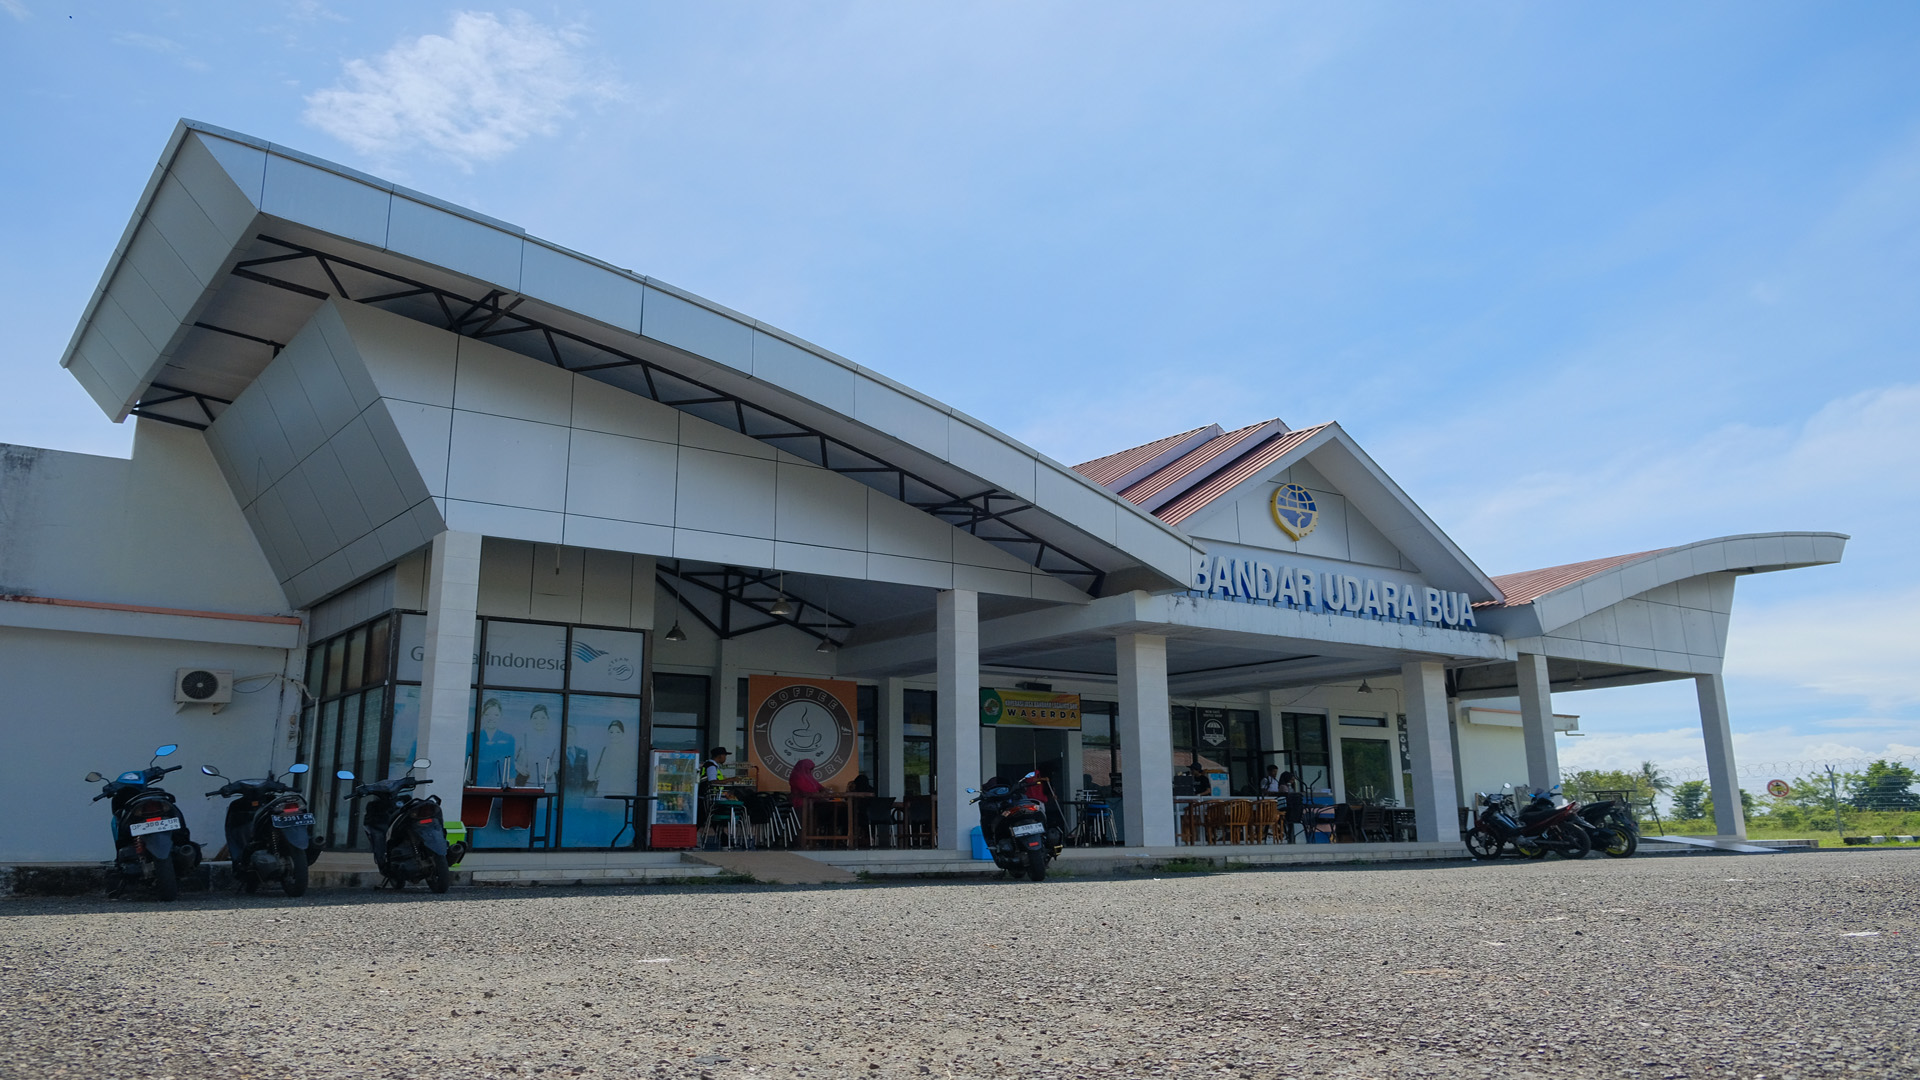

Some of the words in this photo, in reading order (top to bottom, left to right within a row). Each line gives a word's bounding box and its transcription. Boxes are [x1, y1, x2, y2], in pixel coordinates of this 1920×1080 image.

[1192, 555, 1317, 607] BANDAR
[1321, 572, 1420, 621] UDARA
[1423, 586, 1477, 628] BUA
[486, 651, 572, 671] Indonesia
[767, 687, 839, 710] COFFEE
[1007, 708, 1077, 719] WASERDA
